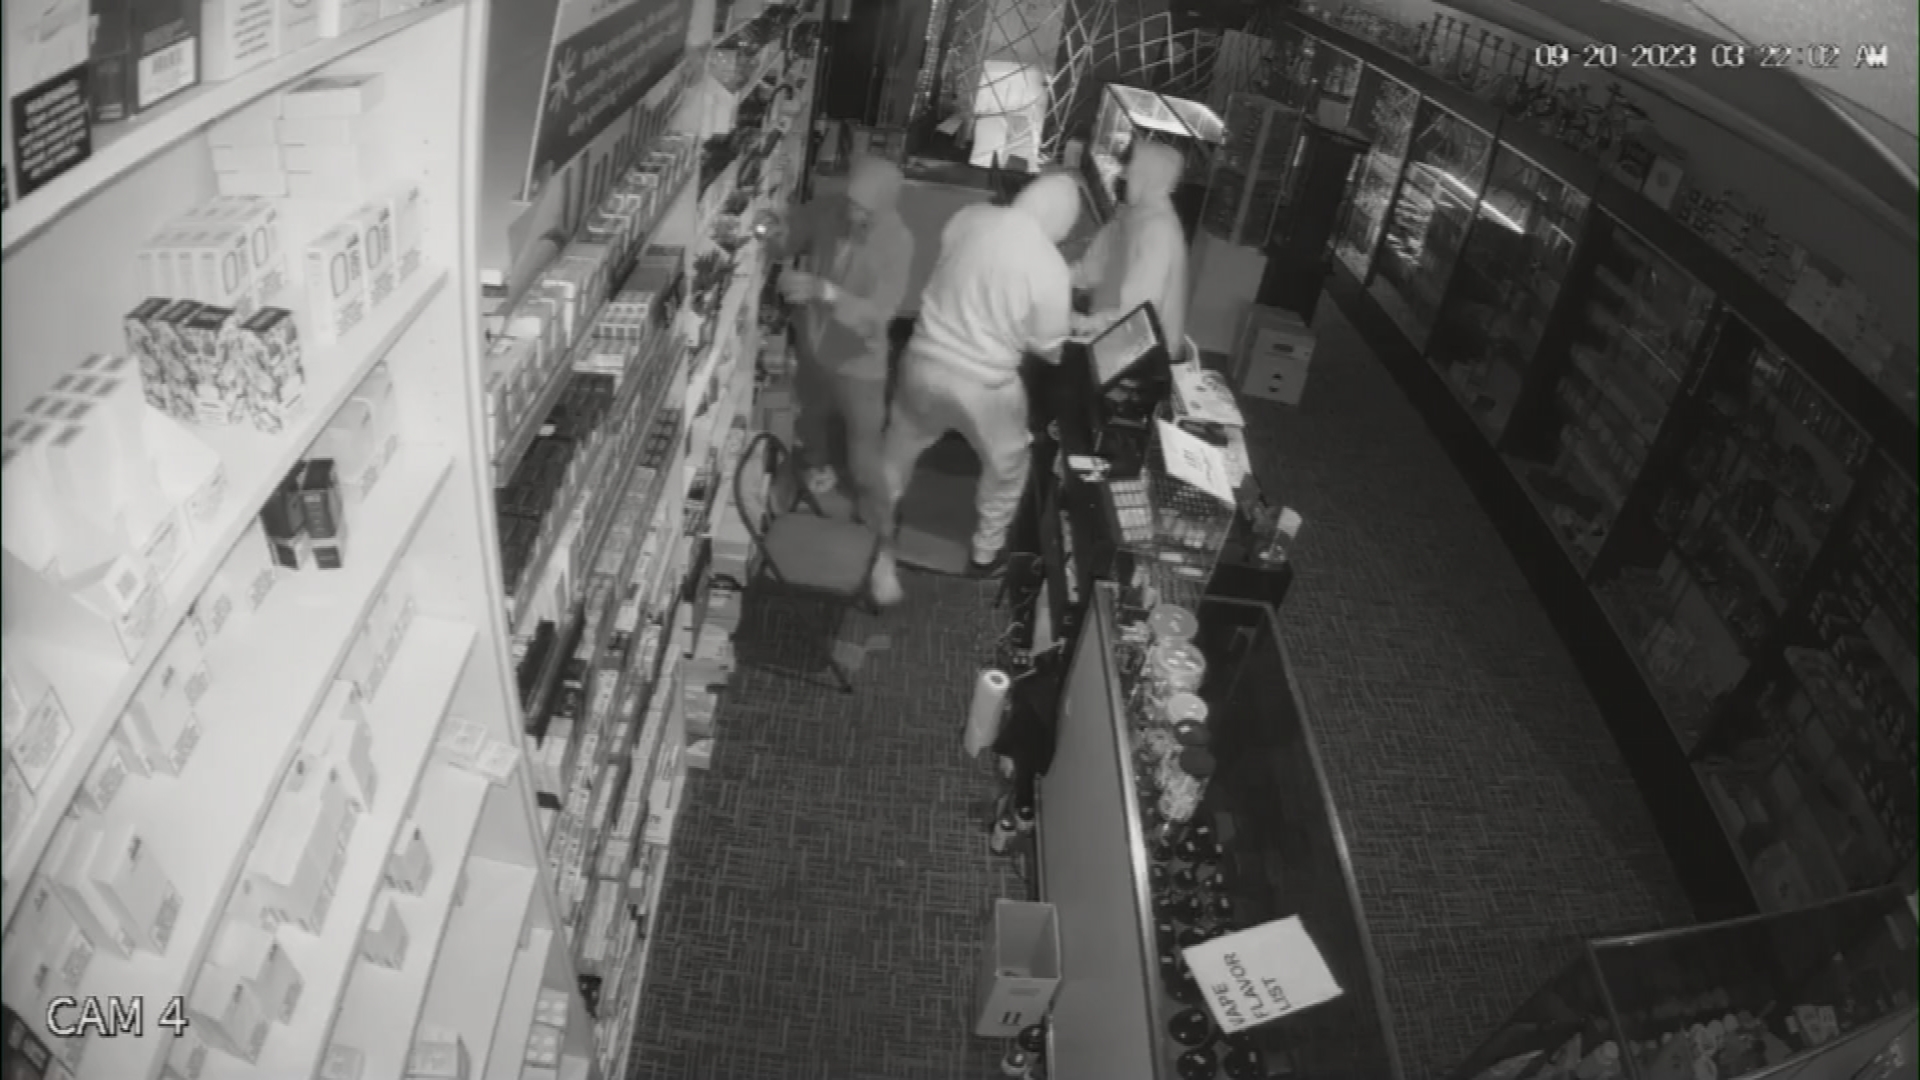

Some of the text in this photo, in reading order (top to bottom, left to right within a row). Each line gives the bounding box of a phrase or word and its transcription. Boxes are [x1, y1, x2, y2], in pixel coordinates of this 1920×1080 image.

[1211, 983, 1246, 1026] VAPE
[1223, 952, 1269, 1020] FLAVOR
[1261, 977, 1292, 1012] LIST
